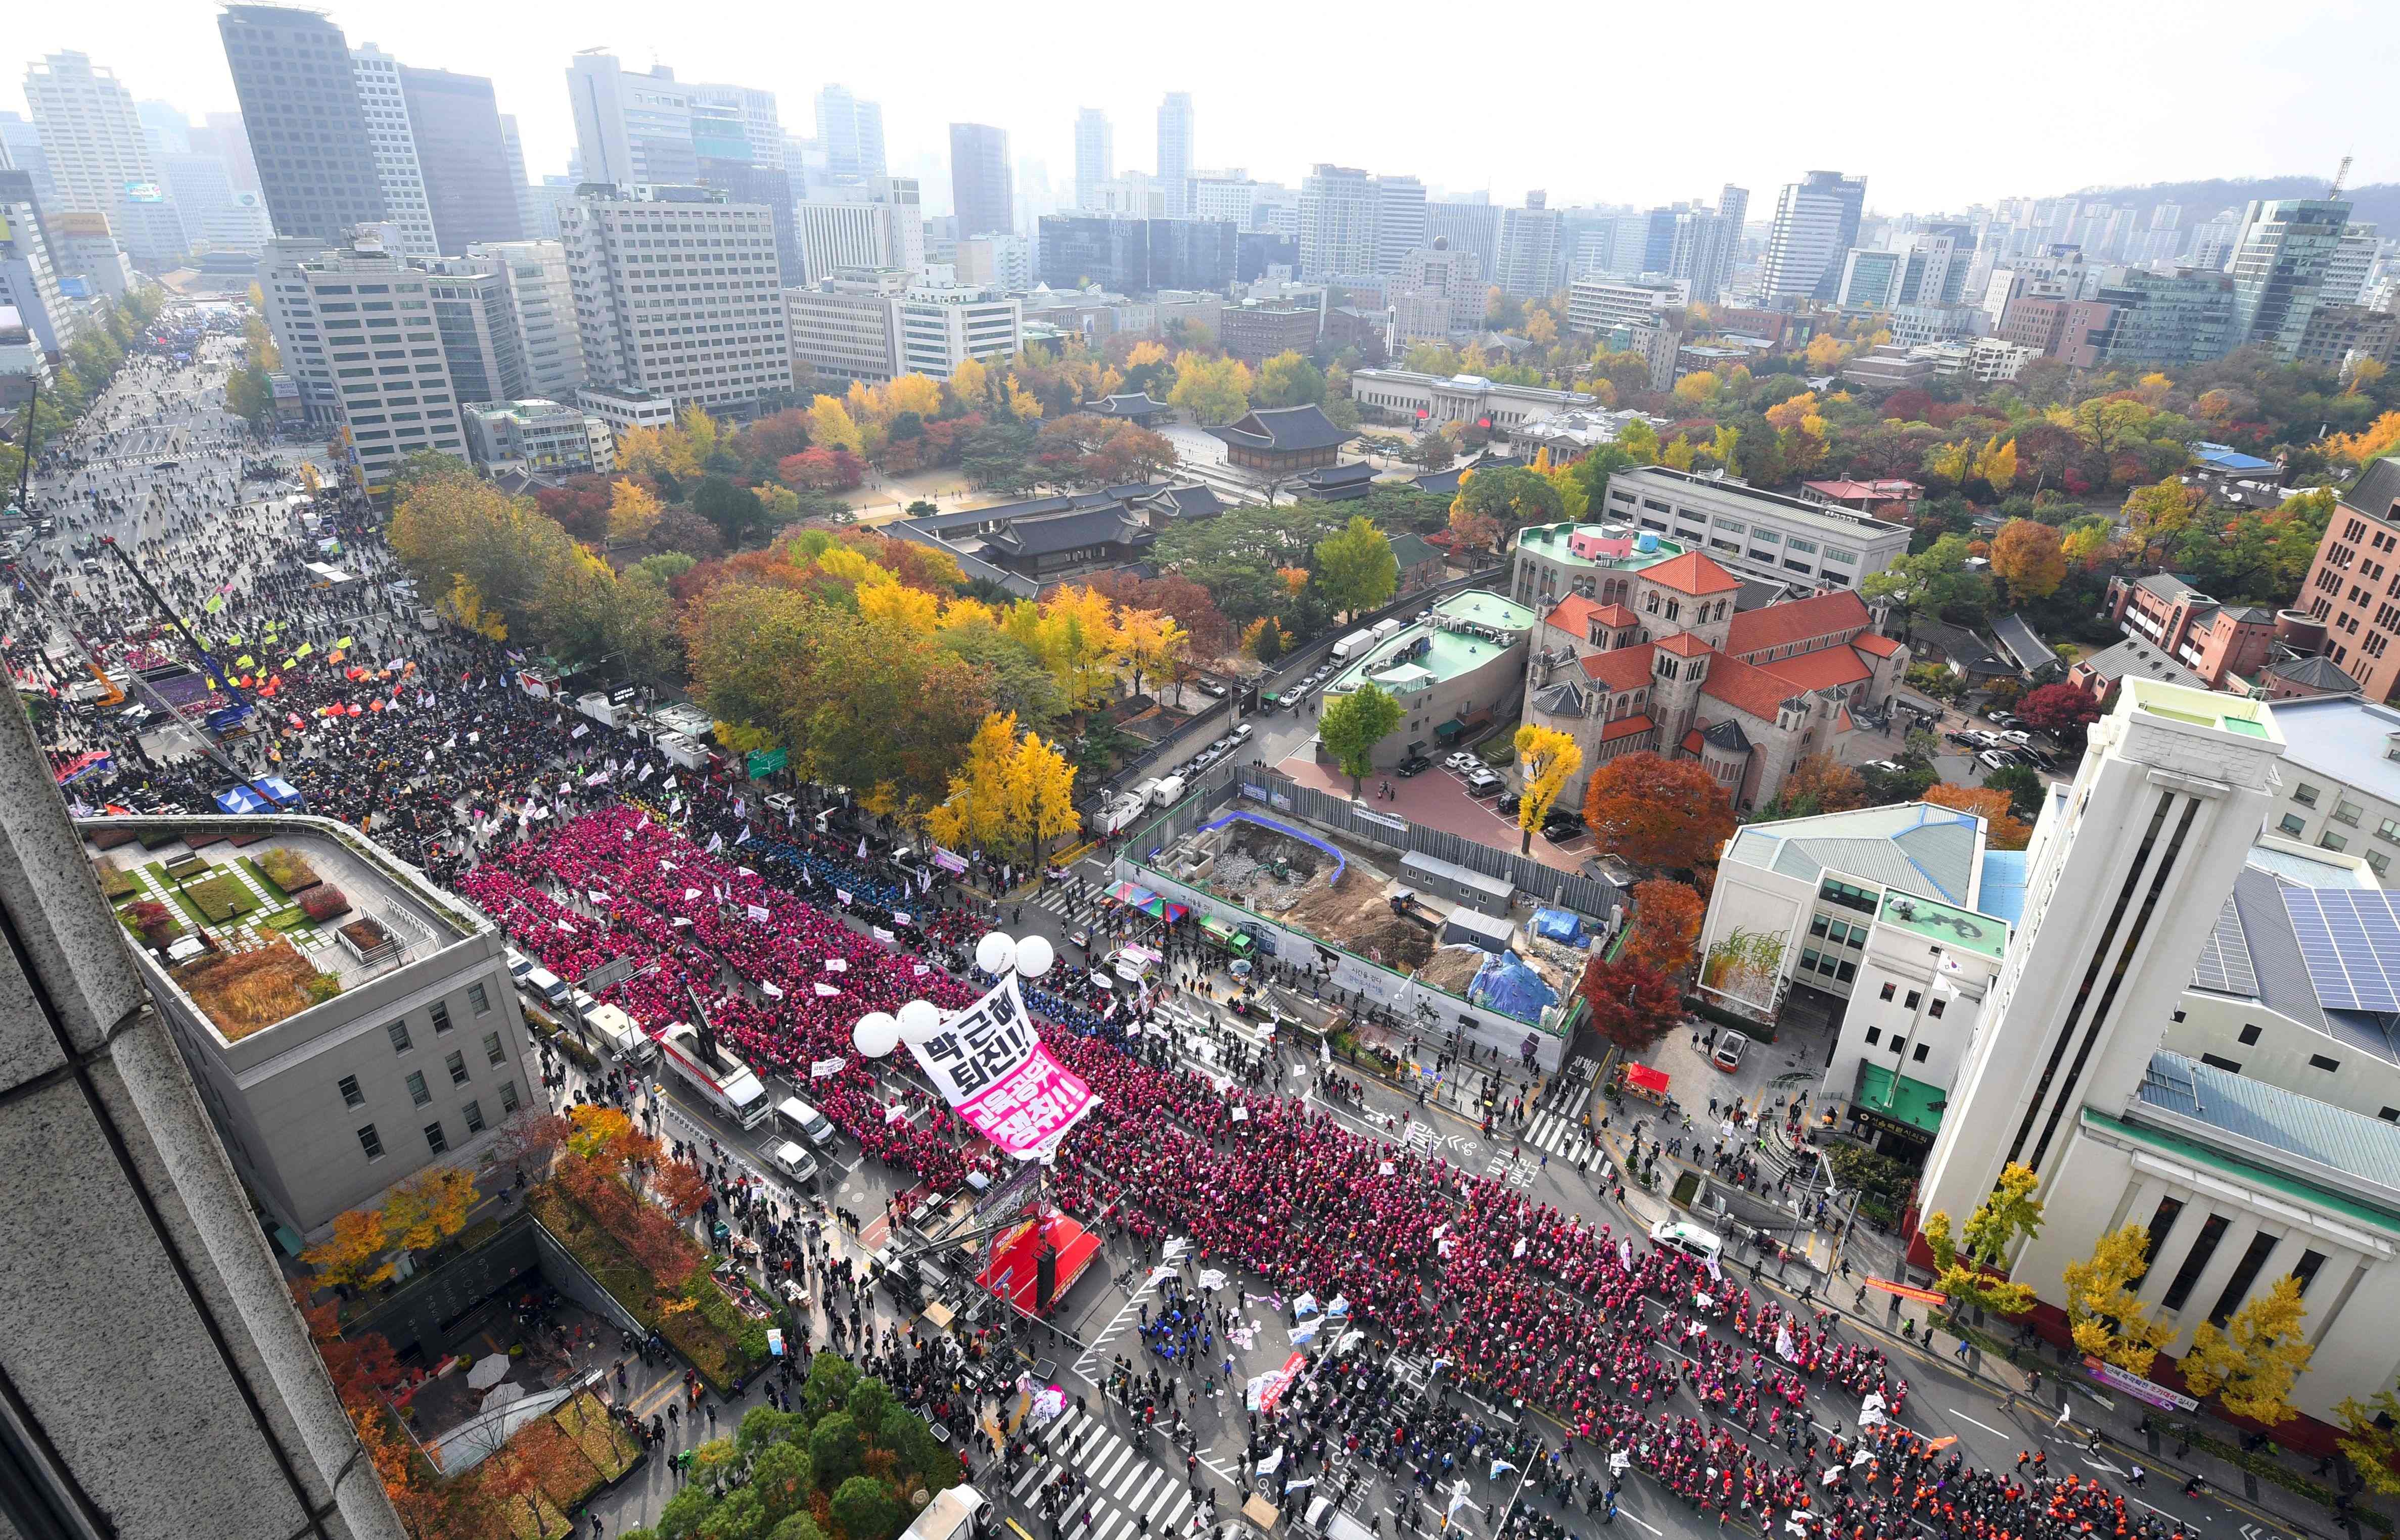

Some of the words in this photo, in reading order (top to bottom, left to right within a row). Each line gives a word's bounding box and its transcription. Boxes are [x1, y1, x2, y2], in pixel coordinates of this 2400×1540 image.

[922, 986, 1017, 1062] 박근혜
[949, 1018, 1030, 1097] 퇴진!!
[991, 1077, 1086, 1147] 쟁취!!
